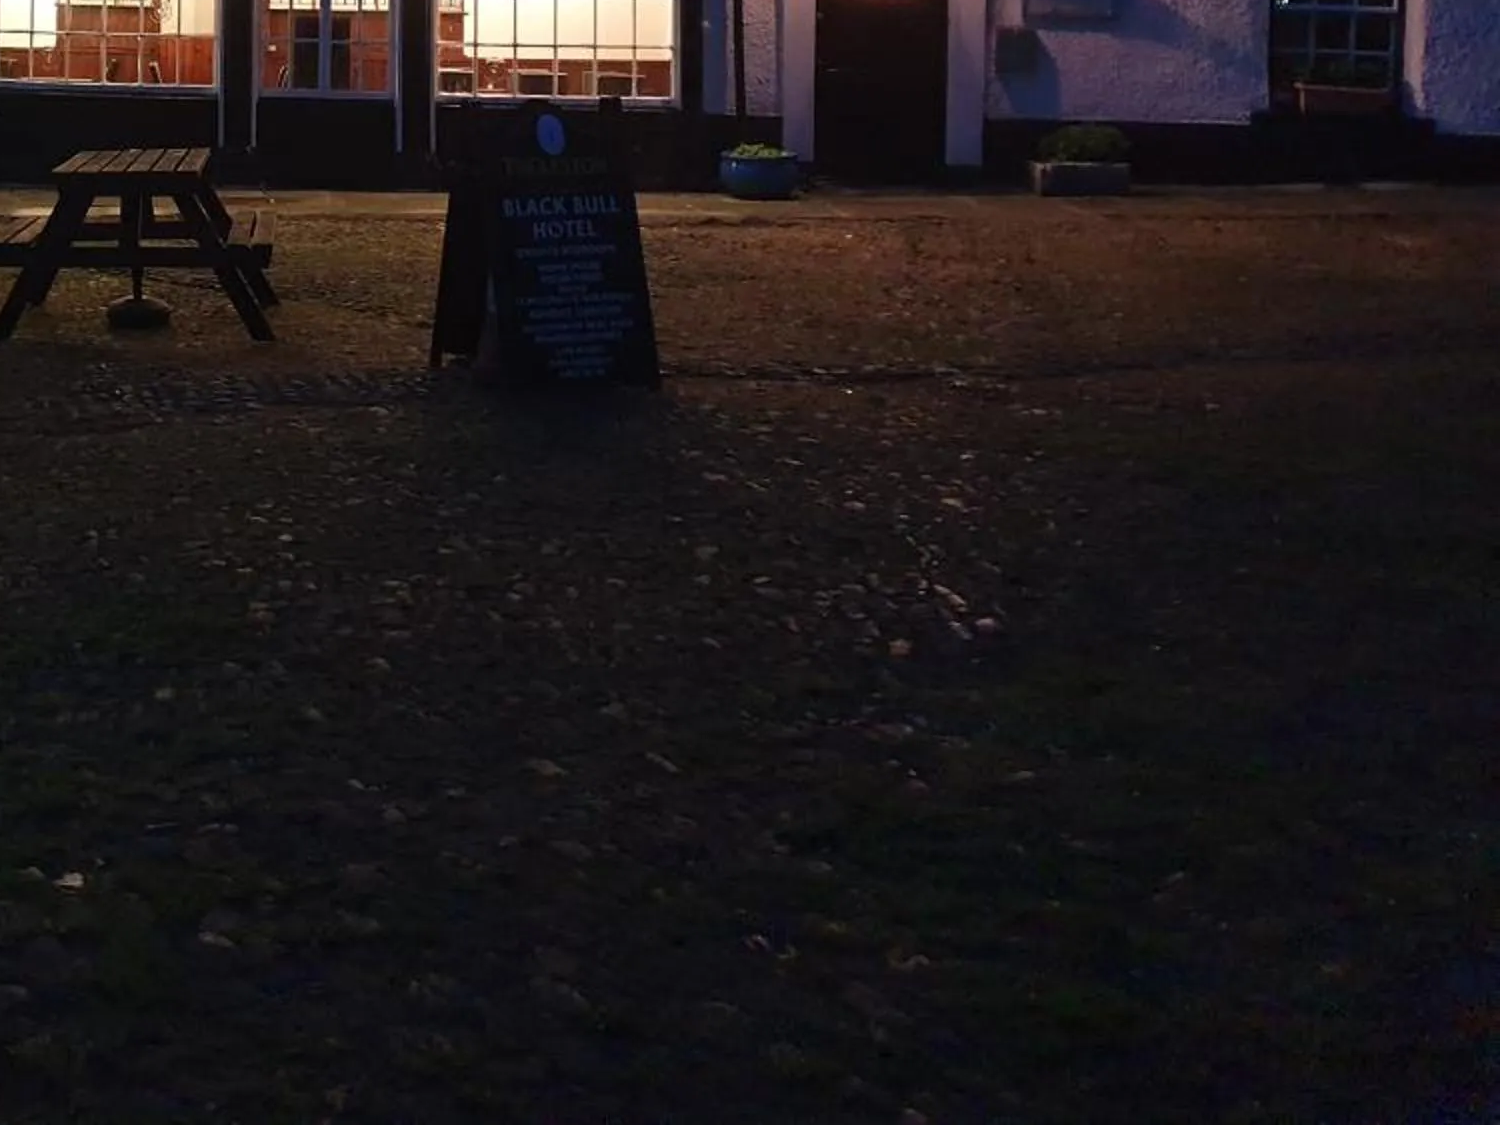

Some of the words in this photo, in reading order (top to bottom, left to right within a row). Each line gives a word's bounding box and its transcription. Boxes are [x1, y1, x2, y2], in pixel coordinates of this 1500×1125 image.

[502, 195, 568, 218] BLACK
[573, 194, 622, 215] BULL
[533, 218, 598, 240] HOTEL
